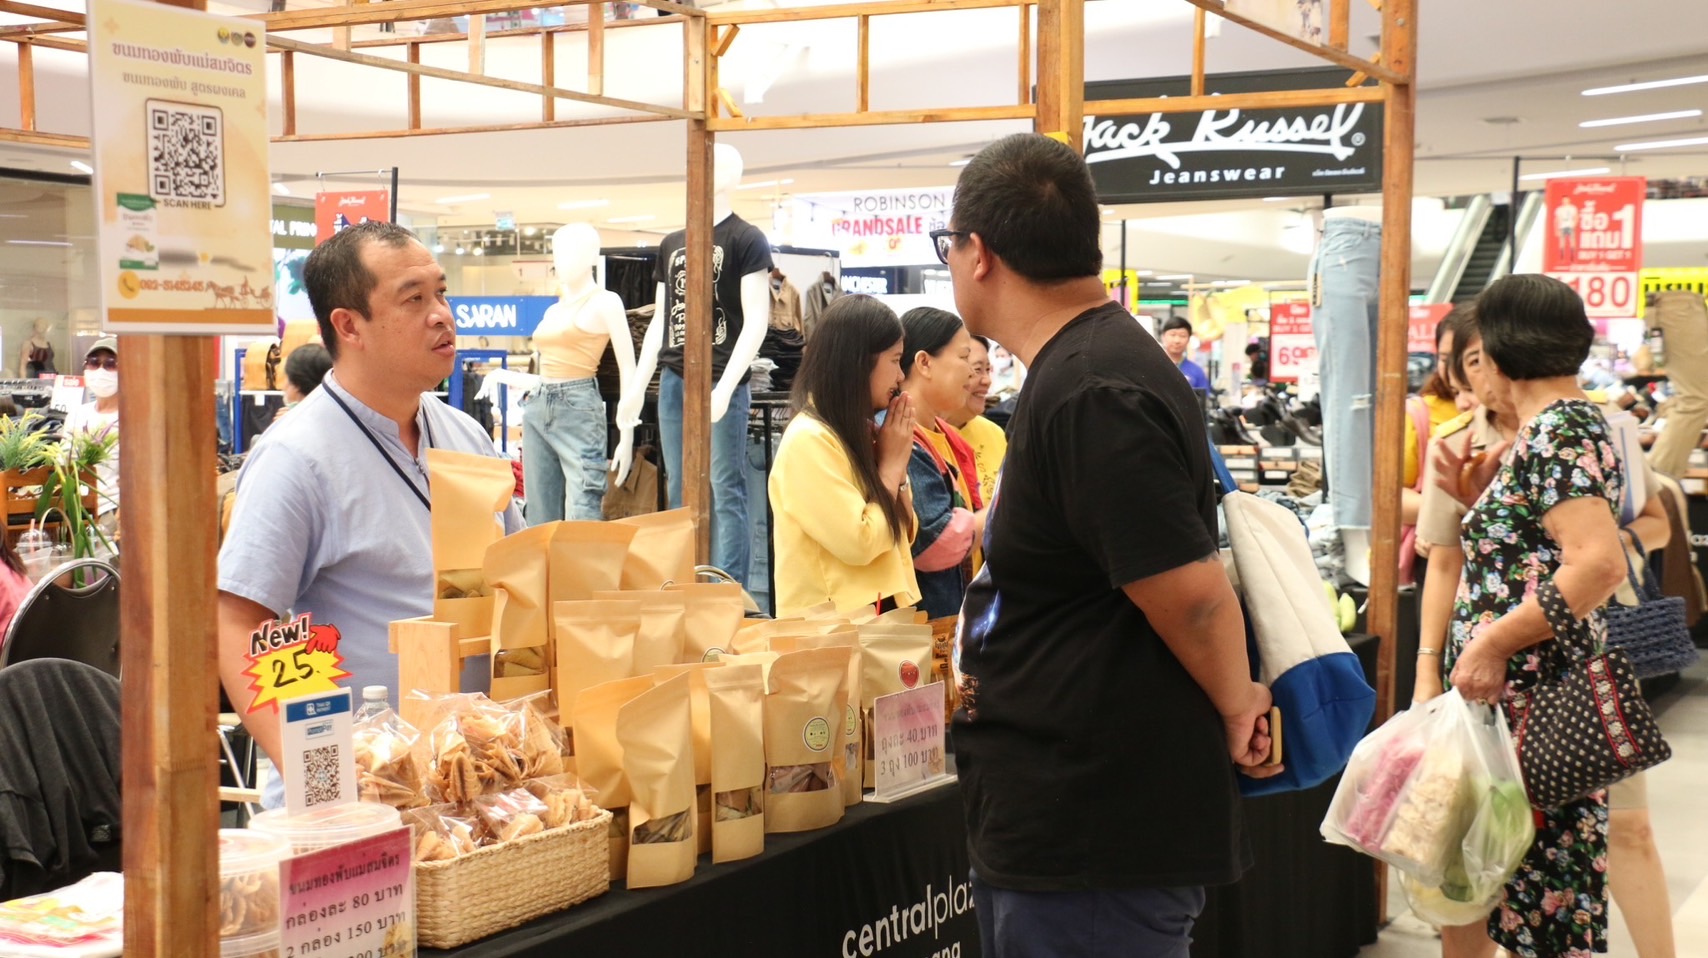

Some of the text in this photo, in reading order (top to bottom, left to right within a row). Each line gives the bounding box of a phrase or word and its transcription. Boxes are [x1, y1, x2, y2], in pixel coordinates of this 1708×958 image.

[1149, 166, 1285, 185] Jeanswear
[163, 199, 190, 209] SCAN
[190, 200, 212, 210] HERE
[854, 193, 946, 213] ROBINSON
[1612, 204, 1636, 250] 1
[455, 304, 517, 328] SARAN
[252, 616, 309, 655] New!
[904, 751, 918, 768] 100
[289, 851, 400, 895] ขนมทองพับแม่สมจิตร
[286, 883, 403, 930] กล่องละ 80 บาท
[286, 946, 295, 958] 2
[300, 926, 341, 955] กล่อง
[347, 921, 372, 940] 150
[377, 911, 406, 930] บาท
